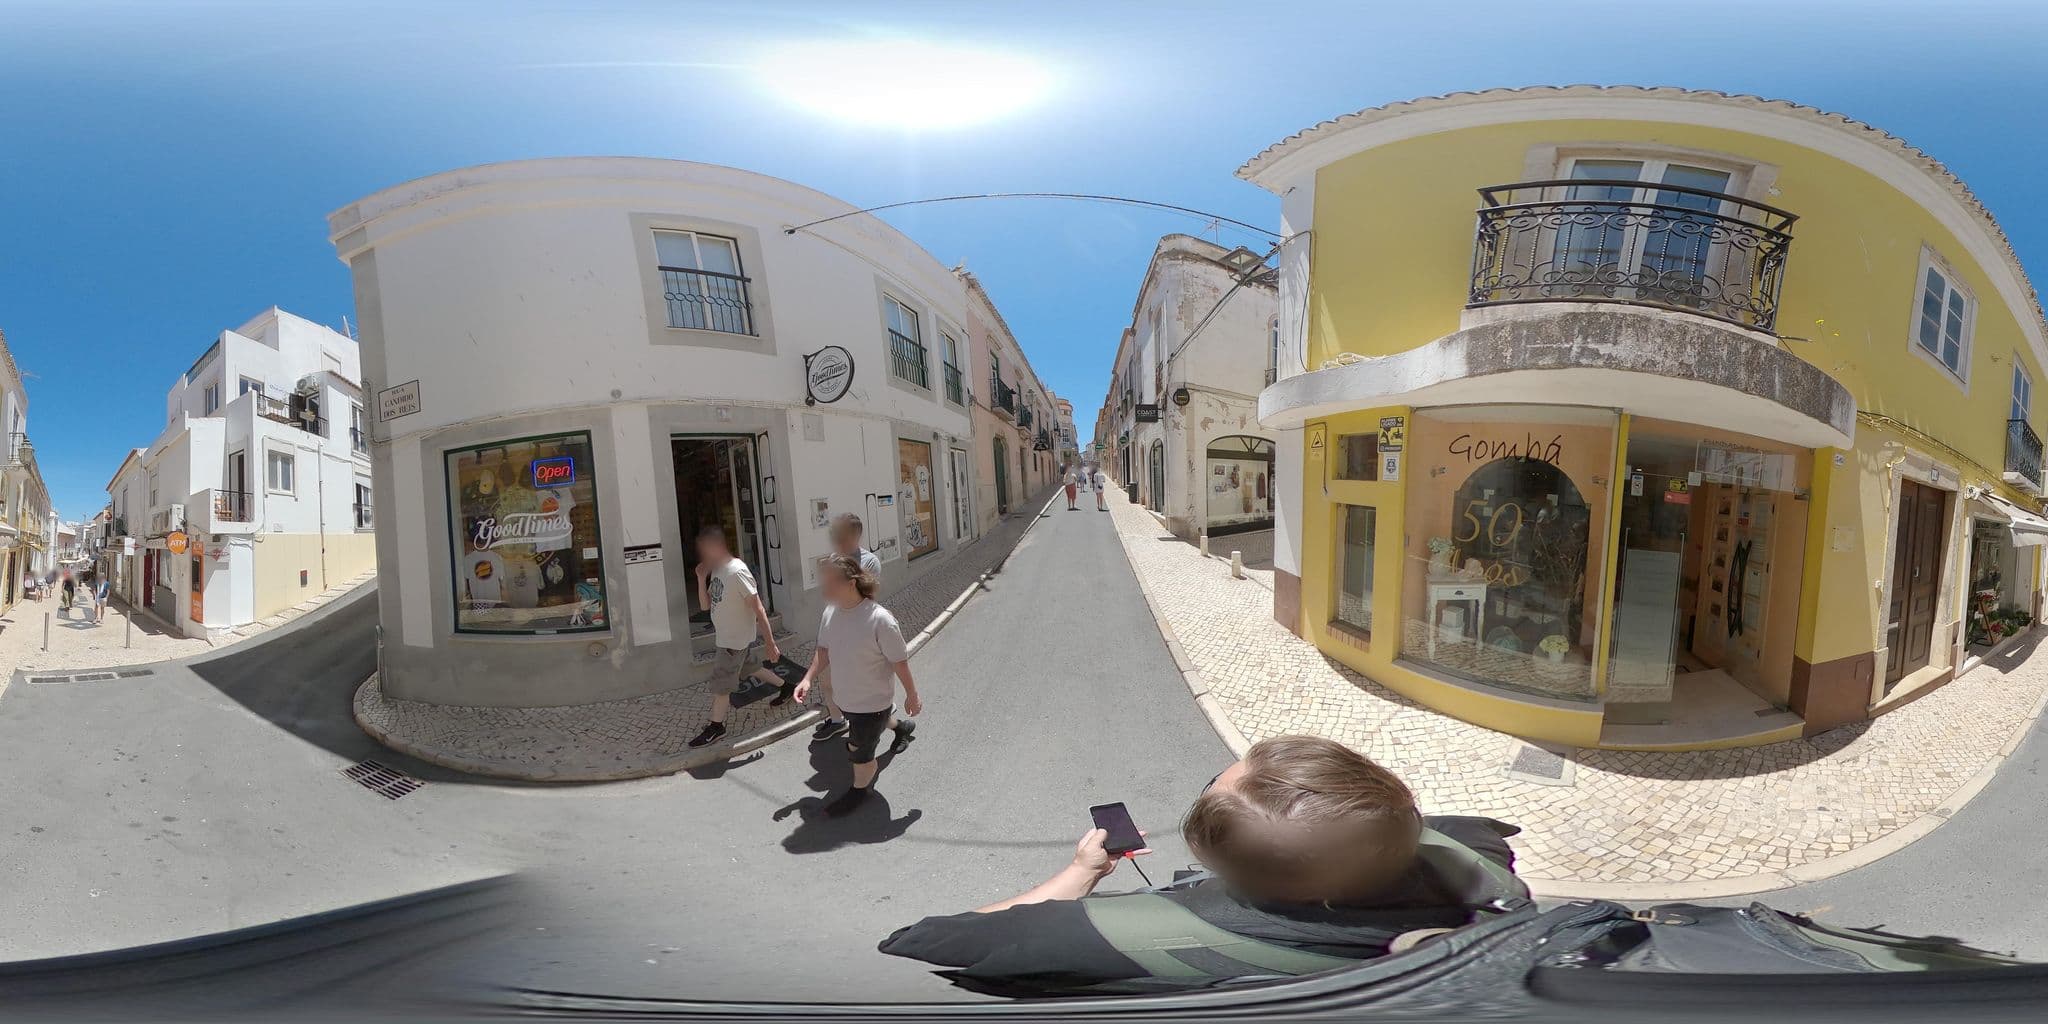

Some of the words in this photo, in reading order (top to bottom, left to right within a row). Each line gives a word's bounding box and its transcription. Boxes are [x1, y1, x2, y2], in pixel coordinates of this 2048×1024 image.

[1448, 432, 1562, 465] Gombá
[536, 465, 570, 482] Open
[1455, 499, 1523, 546] 50
[170, 540, 187, 548] ATM
